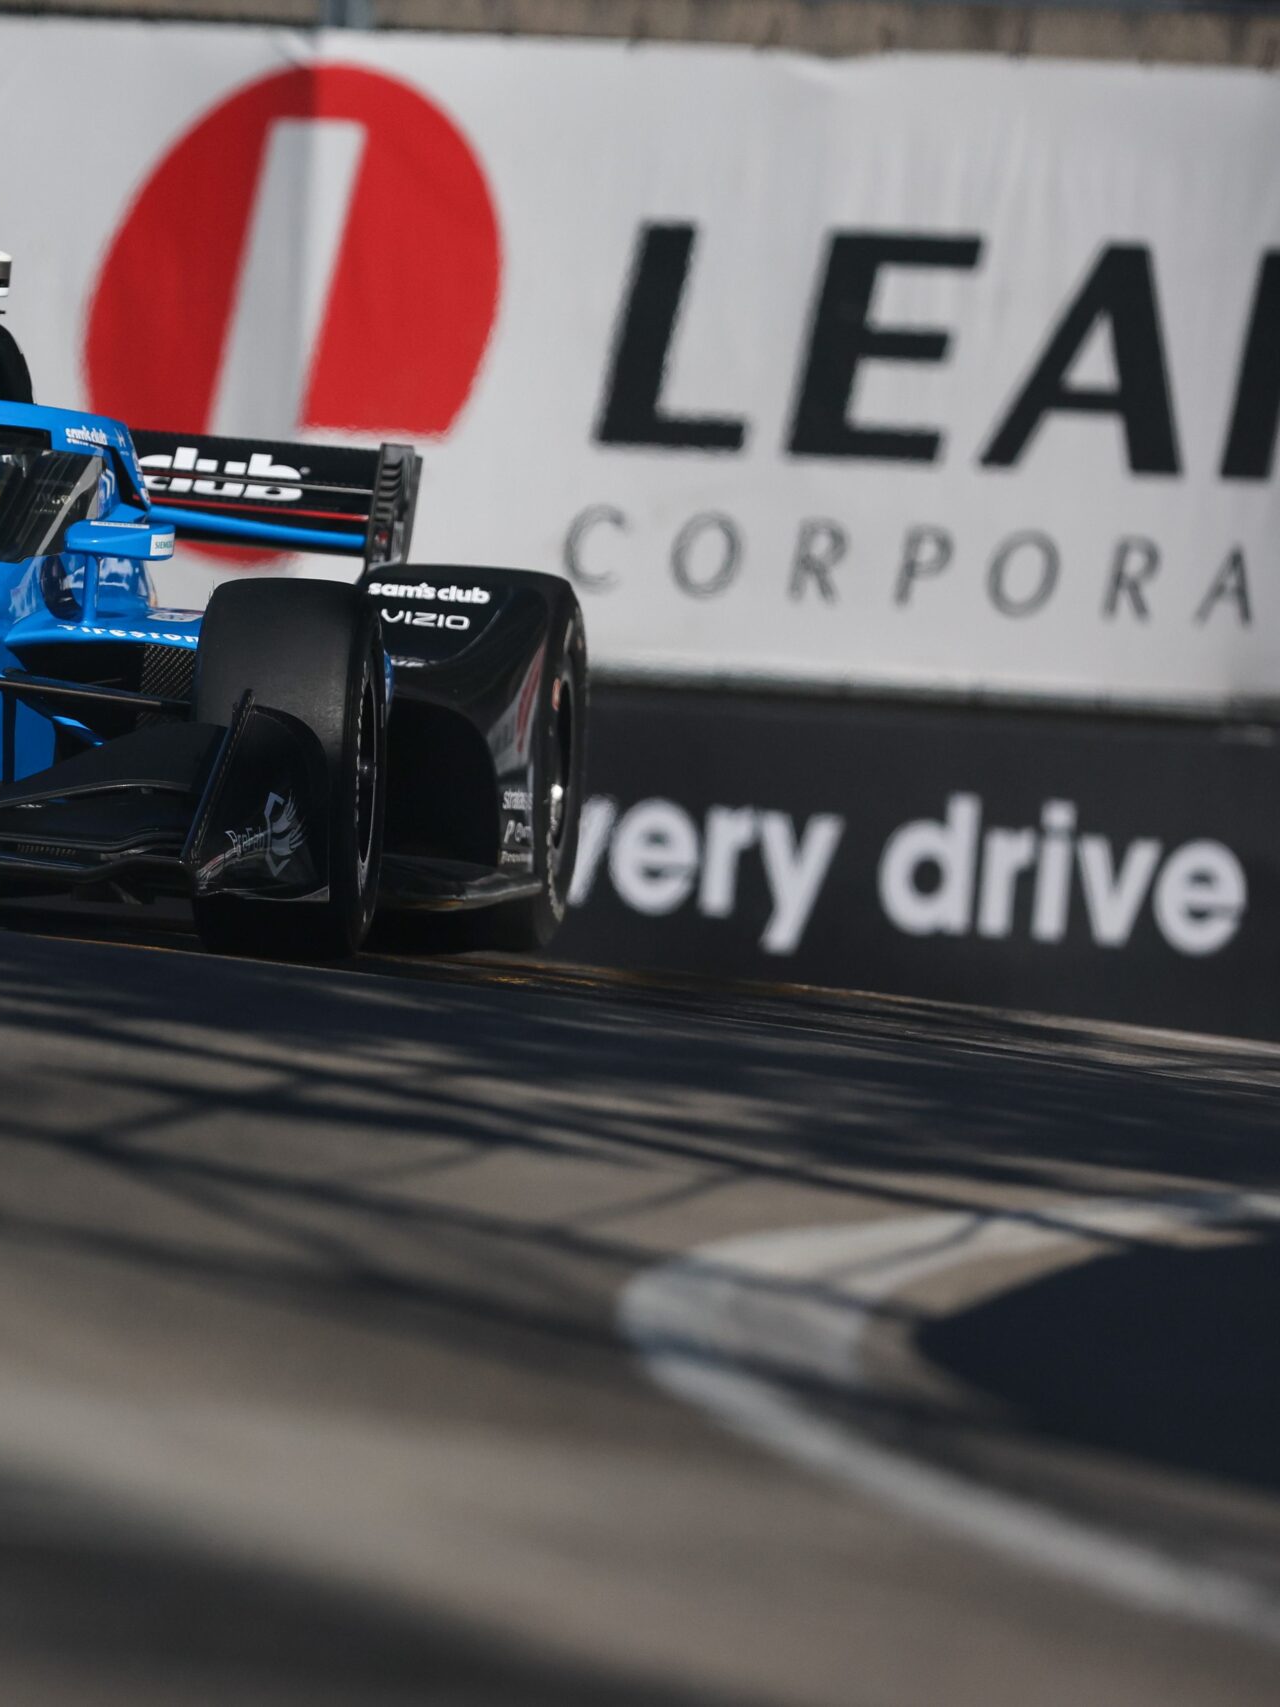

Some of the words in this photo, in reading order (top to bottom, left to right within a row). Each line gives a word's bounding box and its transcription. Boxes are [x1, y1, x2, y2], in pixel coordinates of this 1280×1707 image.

[589, 213, 1280, 483] LEA
[367, 581, 437, 600] sam's
[437, 585, 491, 604] club
[560, 500, 1255, 630] CORPORA
[56, 624, 199, 643] Fireston
[380, 608, 471, 631] VIZIO
[878, 793, 1247, 956] drive
